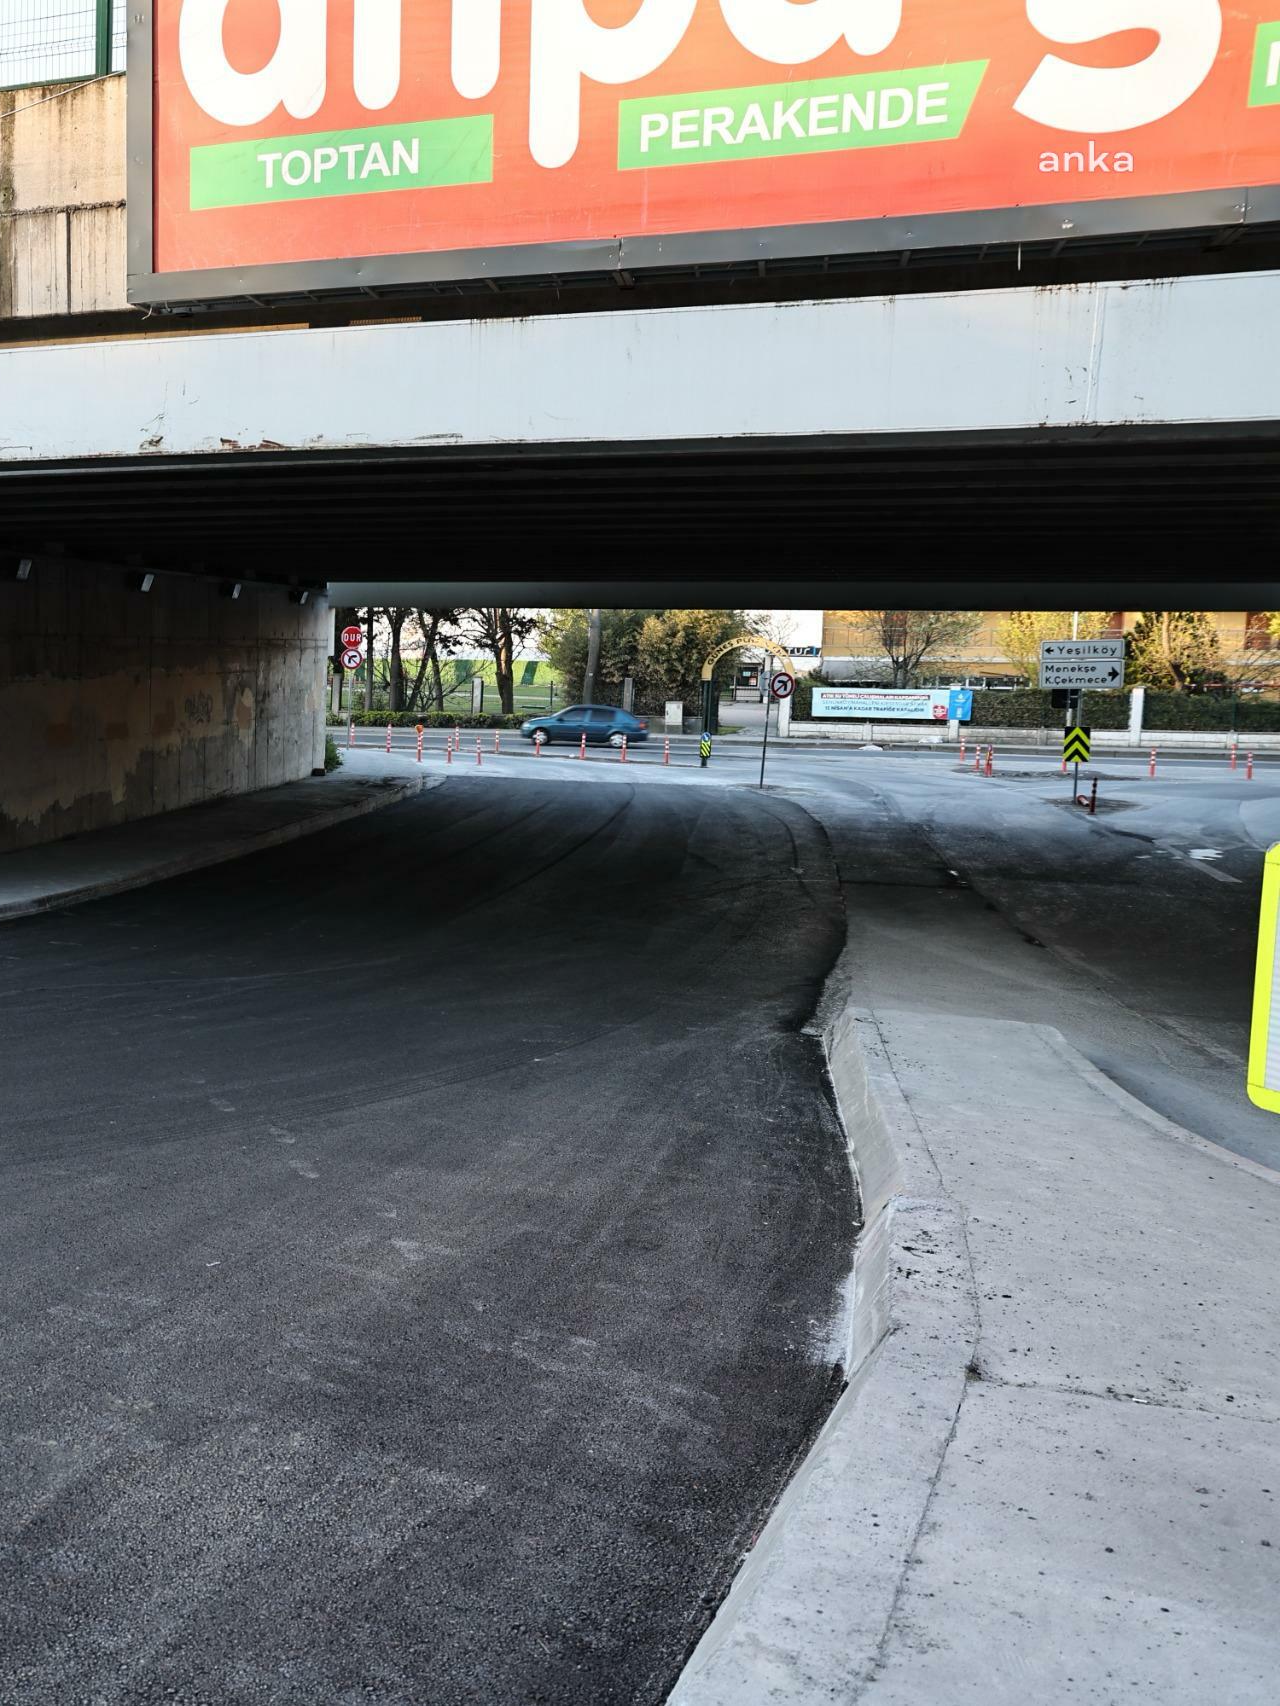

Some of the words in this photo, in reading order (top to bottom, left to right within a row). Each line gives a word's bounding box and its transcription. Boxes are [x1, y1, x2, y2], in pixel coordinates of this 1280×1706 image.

[638, 82, 950, 153] PERAKENDE
[257, 138, 420, 189] TOPTAN
[344, 633, 362, 642] DUR
[1057, 645, 1117, 656] Yeşilköy
[1045, 664, 1097, 673] Menekşe
[1045, 675, 1108, 685] K.Çekmece
